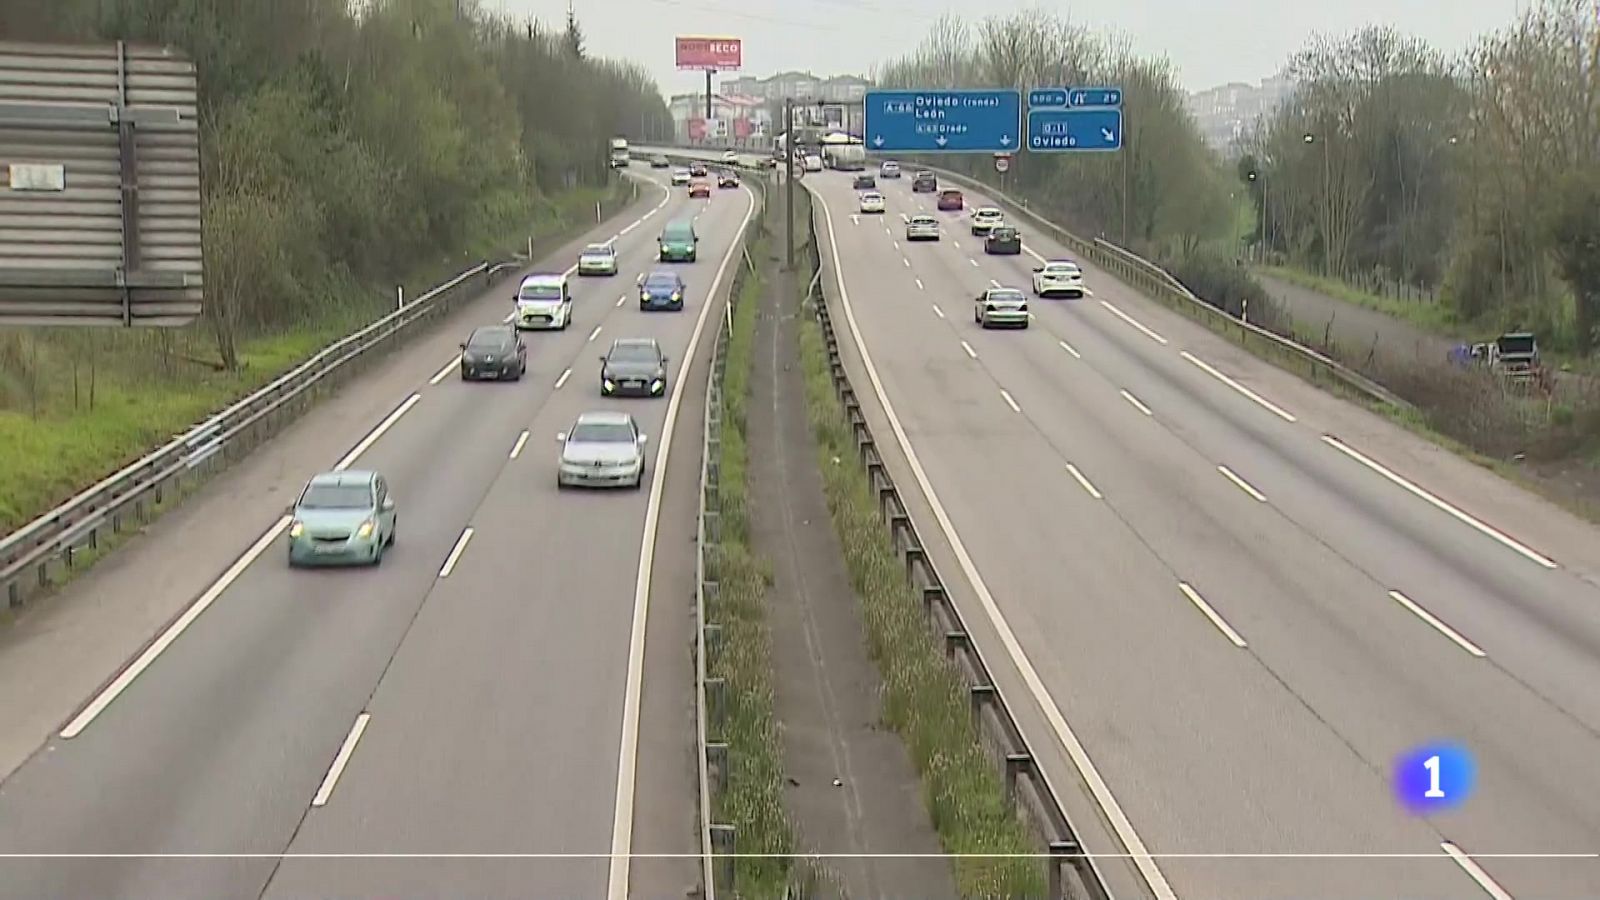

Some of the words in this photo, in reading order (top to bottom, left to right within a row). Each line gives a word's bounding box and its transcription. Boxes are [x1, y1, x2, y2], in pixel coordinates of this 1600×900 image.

[915, 95, 959, 107] Oviedo
[915, 108, 946, 119] León
[1032, 135, 1076, 147] Oviedo
